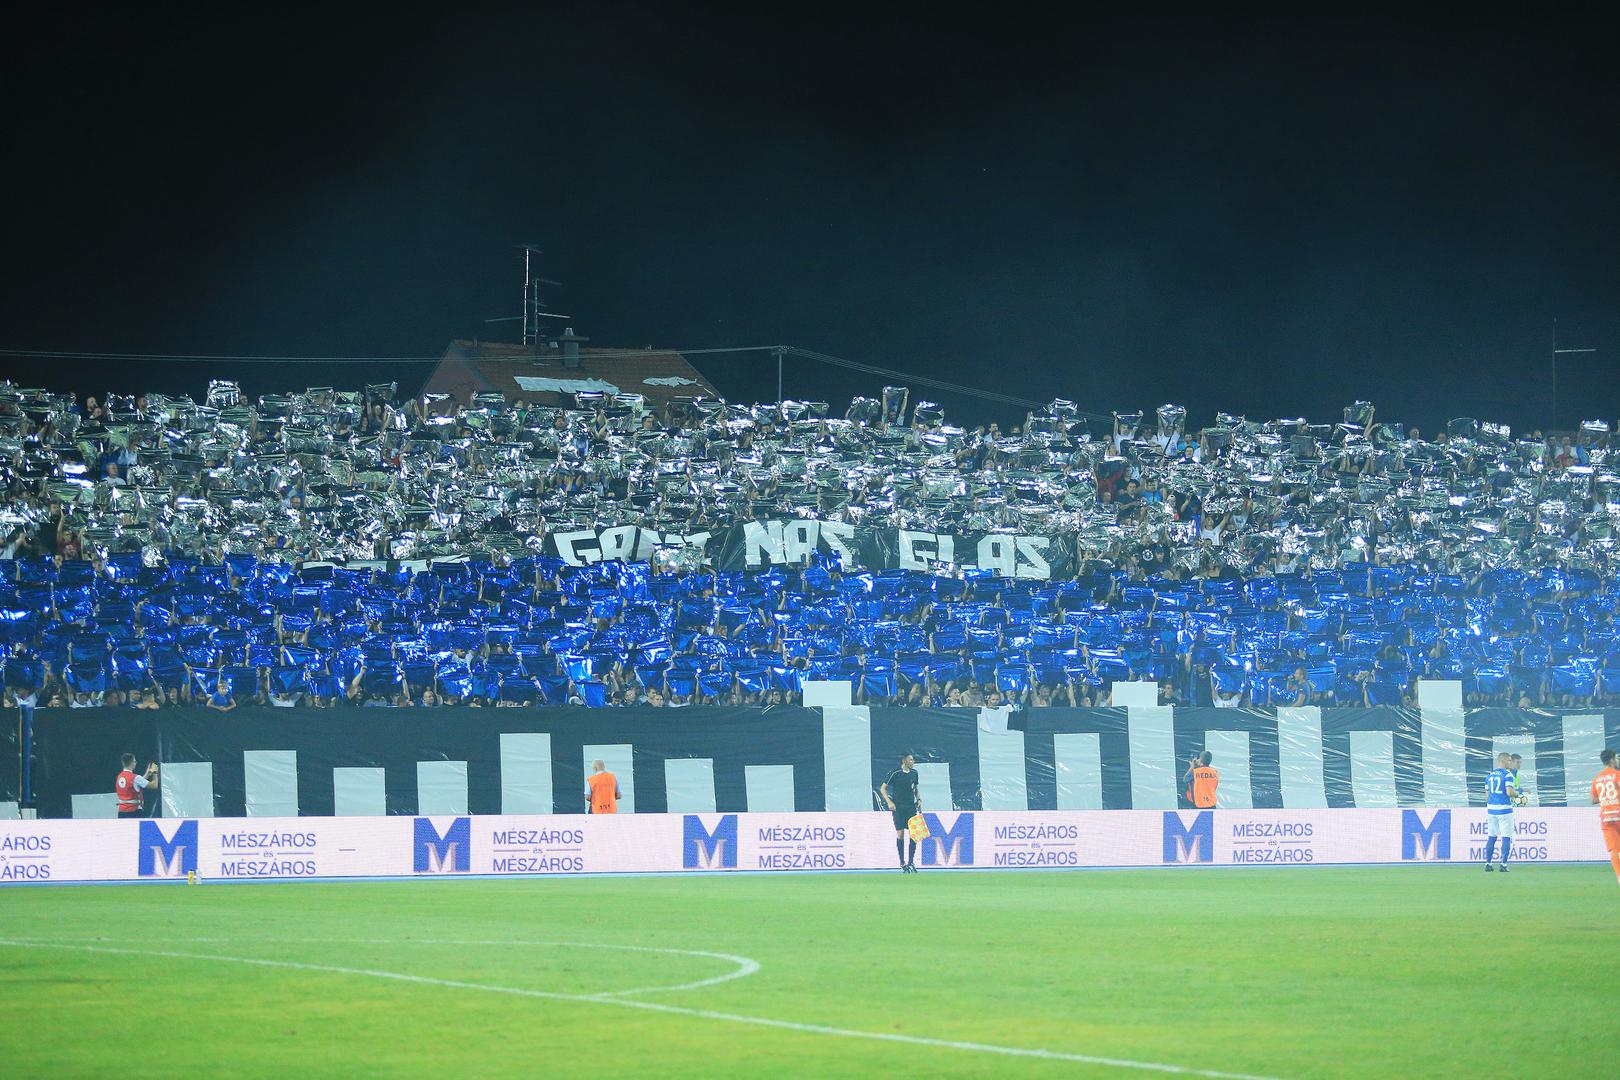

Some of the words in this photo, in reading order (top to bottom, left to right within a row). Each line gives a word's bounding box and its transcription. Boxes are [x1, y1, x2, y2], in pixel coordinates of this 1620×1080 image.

[1488, 776, 1503, 794] 12
[1595, 781, 1618, 802] 28
[492, 828, 584, 845] MÉSZÁROS
[758, 825, 846, 842] MÉSZÁROS
[994, 823, 1078, 839] MÉSZÁROS
[1233, 821, 1313, 837] MÉSZÁROS
[0, 833, 51, 850] ÁROS
[221, 830, 316, 848] MÉSZÁROS
[797, 843, 807, 851] és
[1031, 841, 1041, 849] és
[1267, 839, 1278, 847] és
[263, 849, 274, 858] és
[532, 846, 543, 854] és
[994, 849, 1078, 865] MÉSZÁROS
[1233, 847, 1313, 863] MÉSZÁROS
[221, 858, 316, 876] MÉSZÁROS
[492, 855, 584, 872] MÉSZÁROS
[758, 852, 846, 868] MÉSZÁROS
